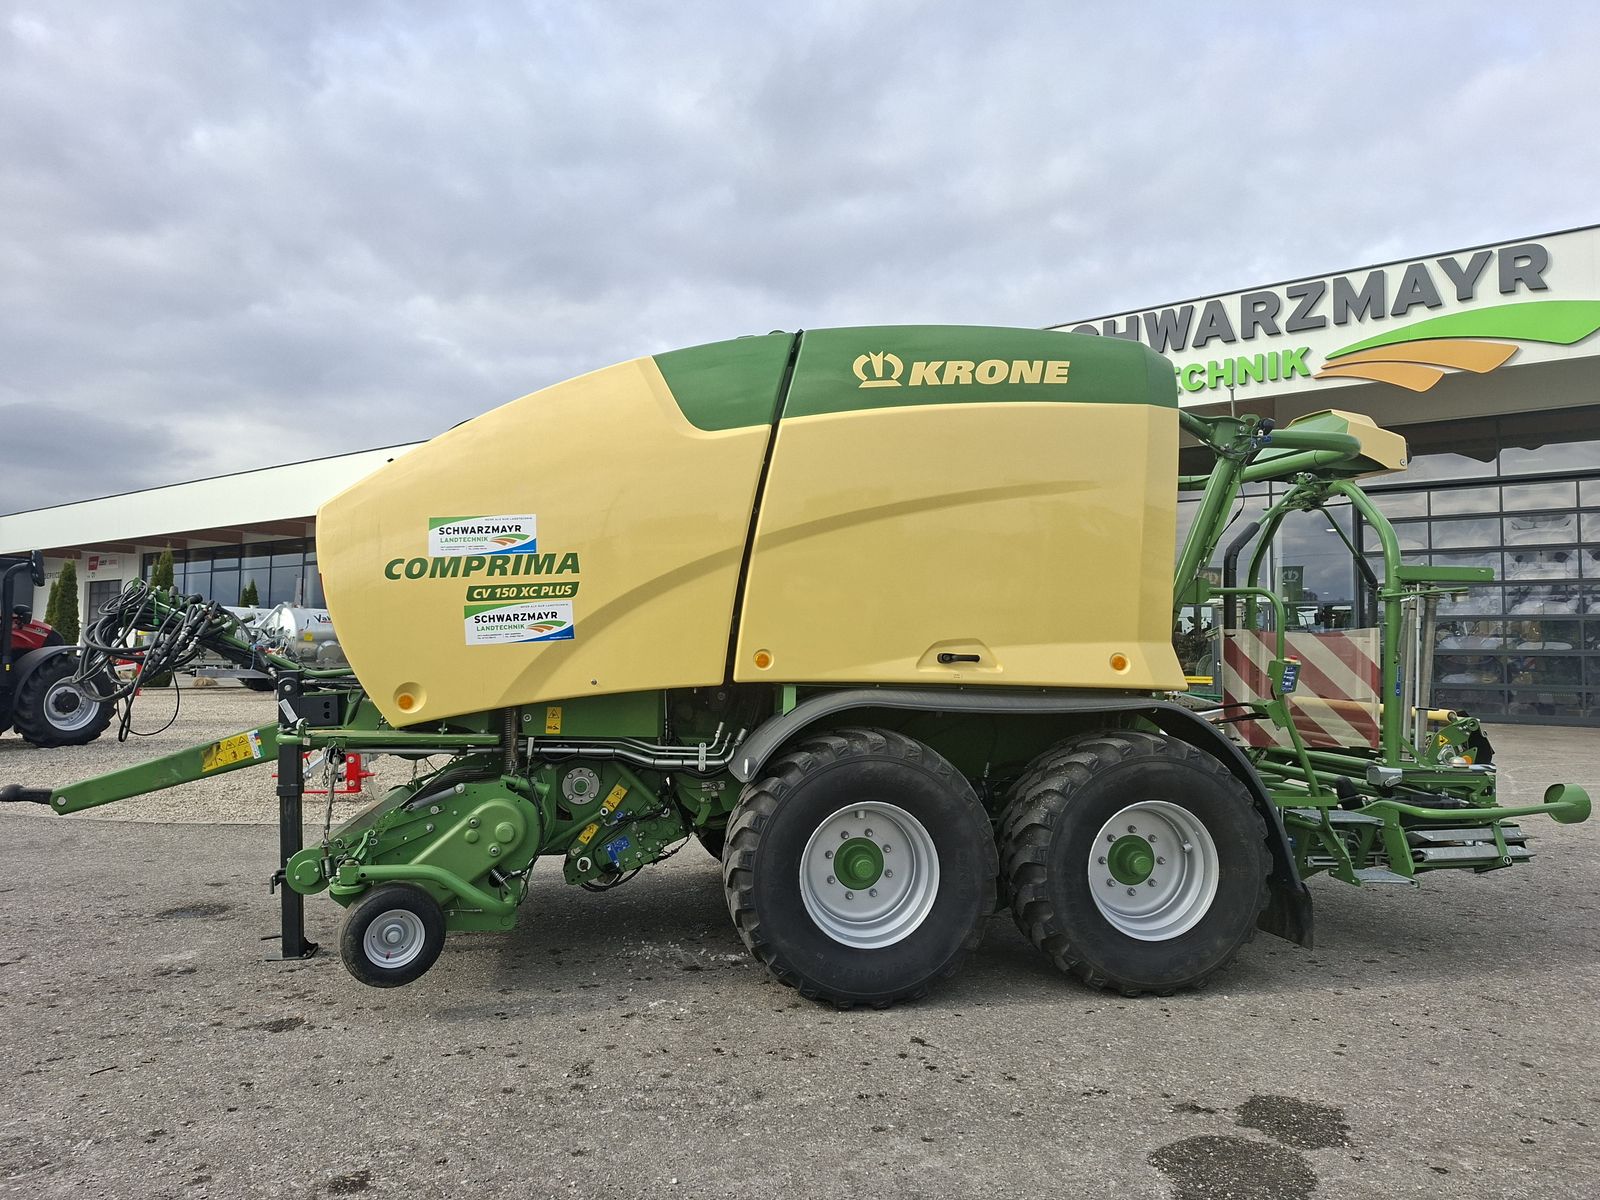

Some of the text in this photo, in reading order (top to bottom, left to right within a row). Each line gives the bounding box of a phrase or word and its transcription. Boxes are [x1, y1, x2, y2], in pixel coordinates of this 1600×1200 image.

[908, 359, 1071, 387] KRONE
[1176, 346, 1311, 394] CHNIK
[438, 524, 522, 536] SCHWARZMAYR
[440, 536, 489, 544] LANDTECHNIK
[384, 552, 581, 581] COMPRIMA
[473, 585, 573, 599] CV 150 XC PLUS
[474, 611, 558, 624] SCHWARZMAYR
[476, 623, 526, 632] LANDTECHNIK
